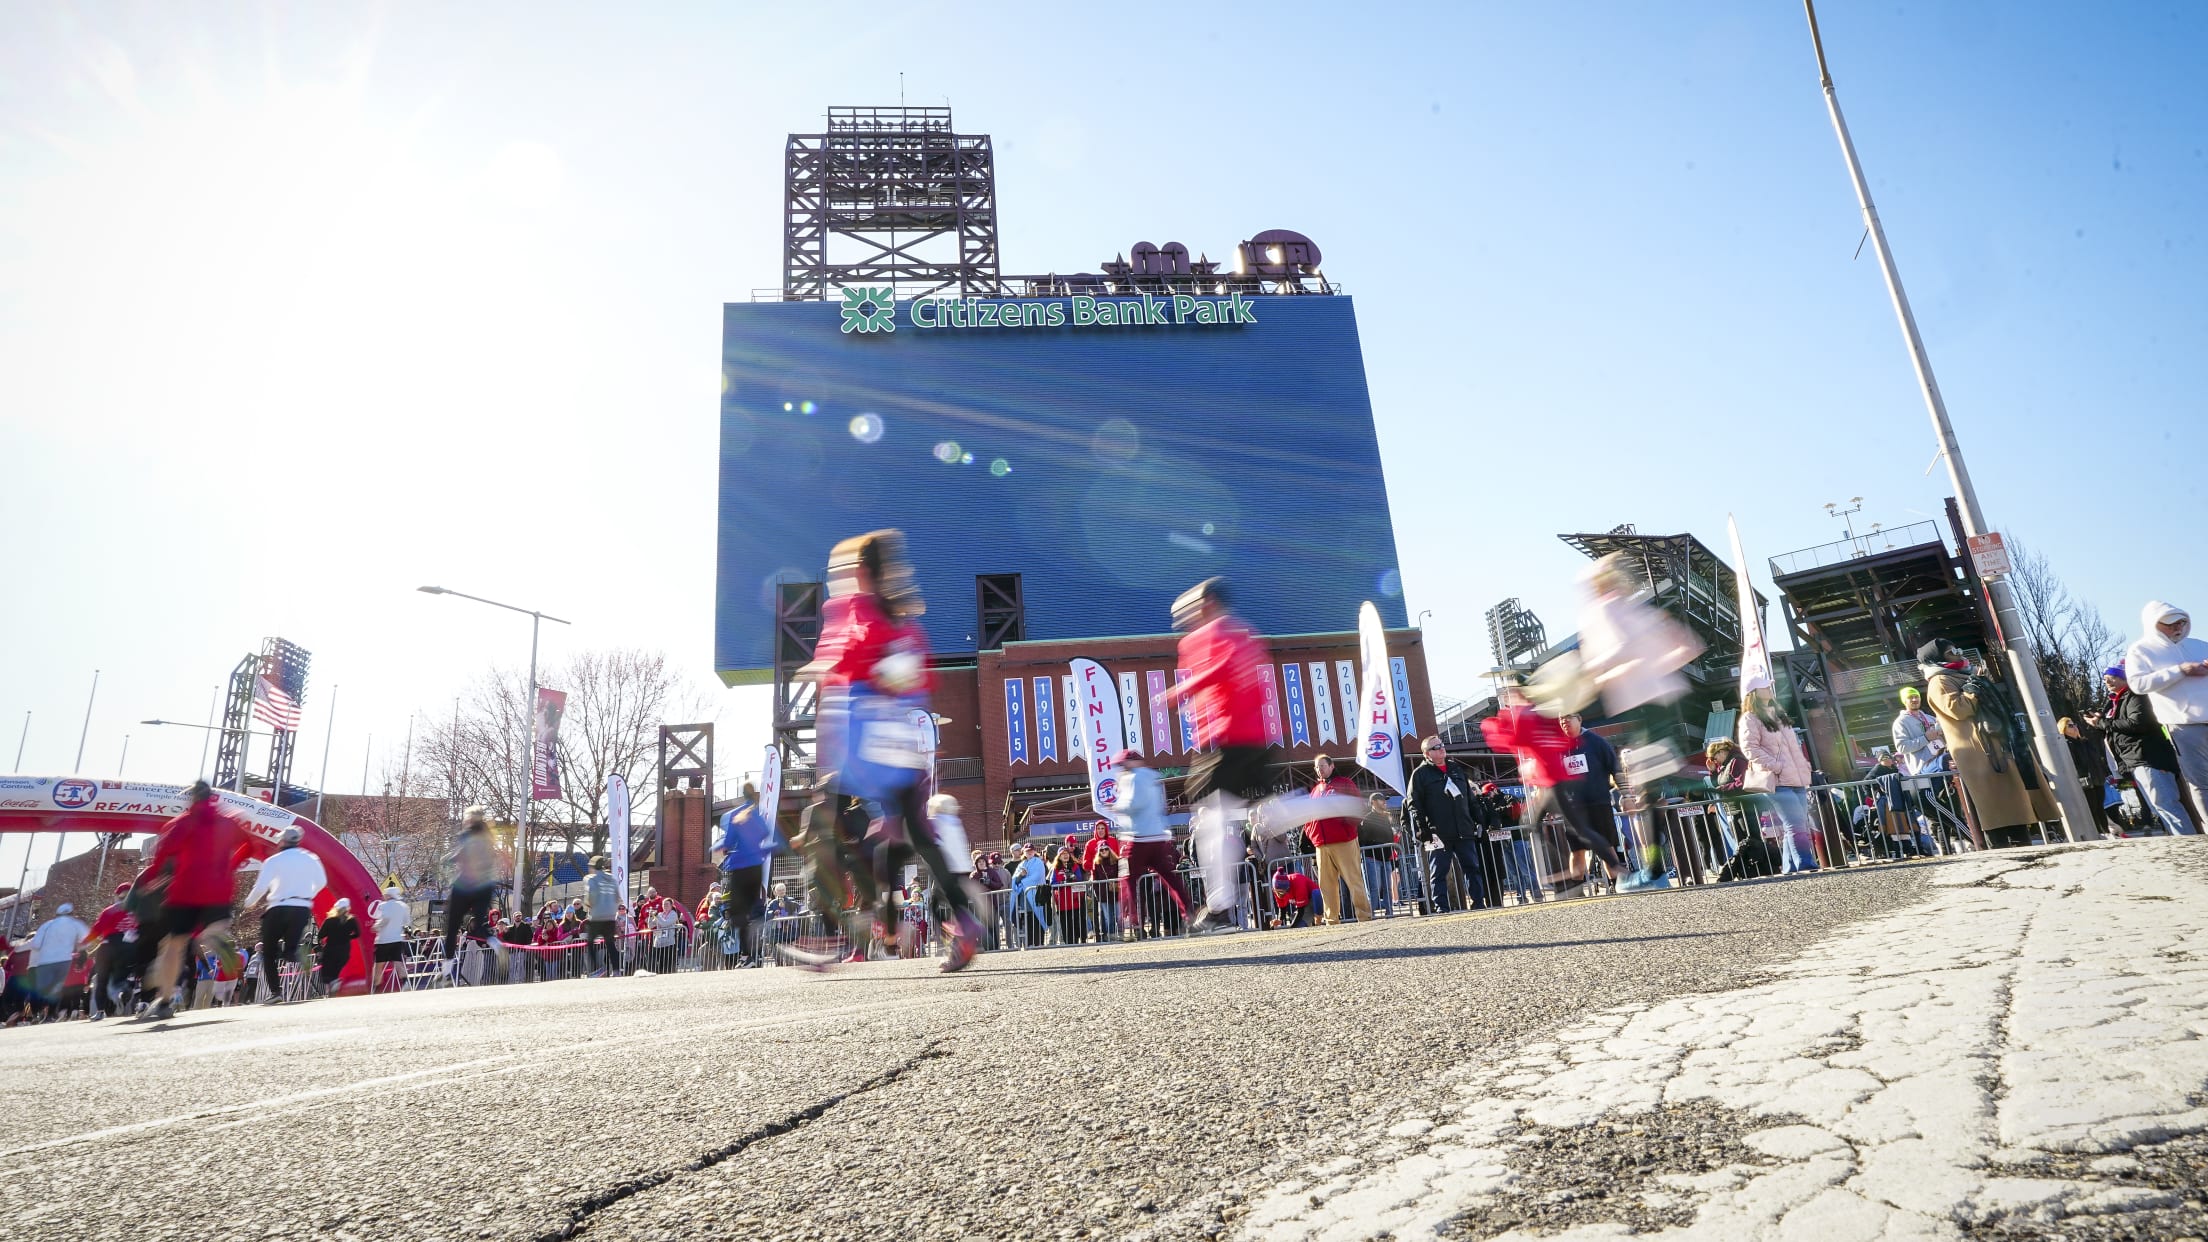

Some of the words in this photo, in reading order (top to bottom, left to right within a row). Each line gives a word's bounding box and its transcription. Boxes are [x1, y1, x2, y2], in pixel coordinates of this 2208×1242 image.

[911, 297, 1065, 328] Citizens
[1072, 293, 1169, 326] Bank
[1173, 291, 1258, 324] Park
[1971, 543, 2003, 554] STOING
[1977, 535, 1991, 545] NO
[1011, 684, 1022, 752] 1915
[1040, 682, 1051, 750] 1950
[1069, 681, 1080, 748] 1976
[1085, 666, 1112, 773] FINISH
[1126, 678, 1137, 744] 1978
[1153, 676, 1165, 742] 1980
[1262, 670, 1277, 735] 2008
[1288, 669, 1303, 734] 2009
[1315, 667, 1330, 732] 2010
[1342, 666, 1356, 730] 2011
[1394, 662, 1410, 726] 2023
[55, 785, 94, 802] 5K
[94, 801, 167, 814] RE/MAX
[165, 787, 193, 796] Cete
[223, 797, 255, 809] TOYOTA
[1076, 821, 1096, 831] LEF
